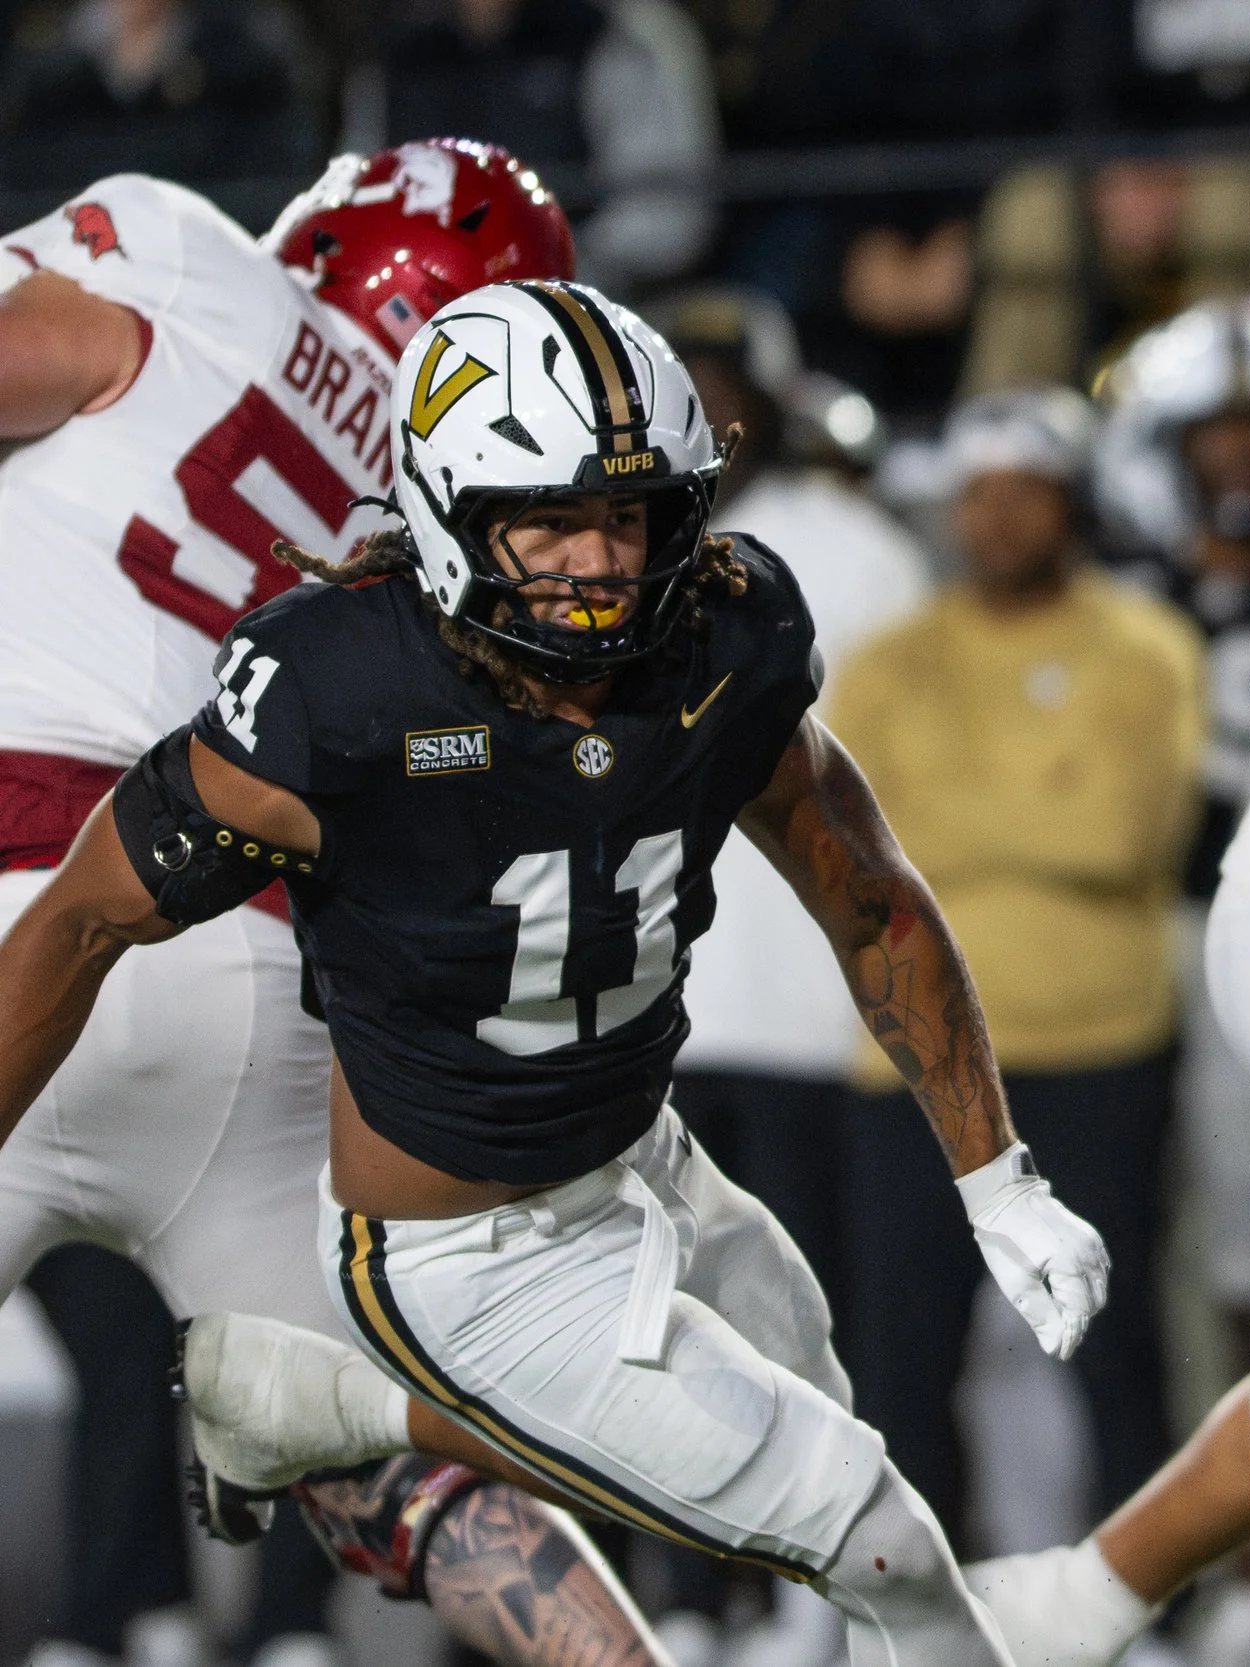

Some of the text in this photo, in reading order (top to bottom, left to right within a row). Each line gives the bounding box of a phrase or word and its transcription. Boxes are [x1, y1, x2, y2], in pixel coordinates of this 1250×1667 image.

[409, 329, 500, 443] V
[602, 452, 656, 476] VUFB
[216, 636, 281, 755] 11
[409, 755, 488, 771] CONCRETE
[422, 732, 488, 761] SRM
[576, 737, 611, 776] SEC
[475, 828, 684, 1057] 11
